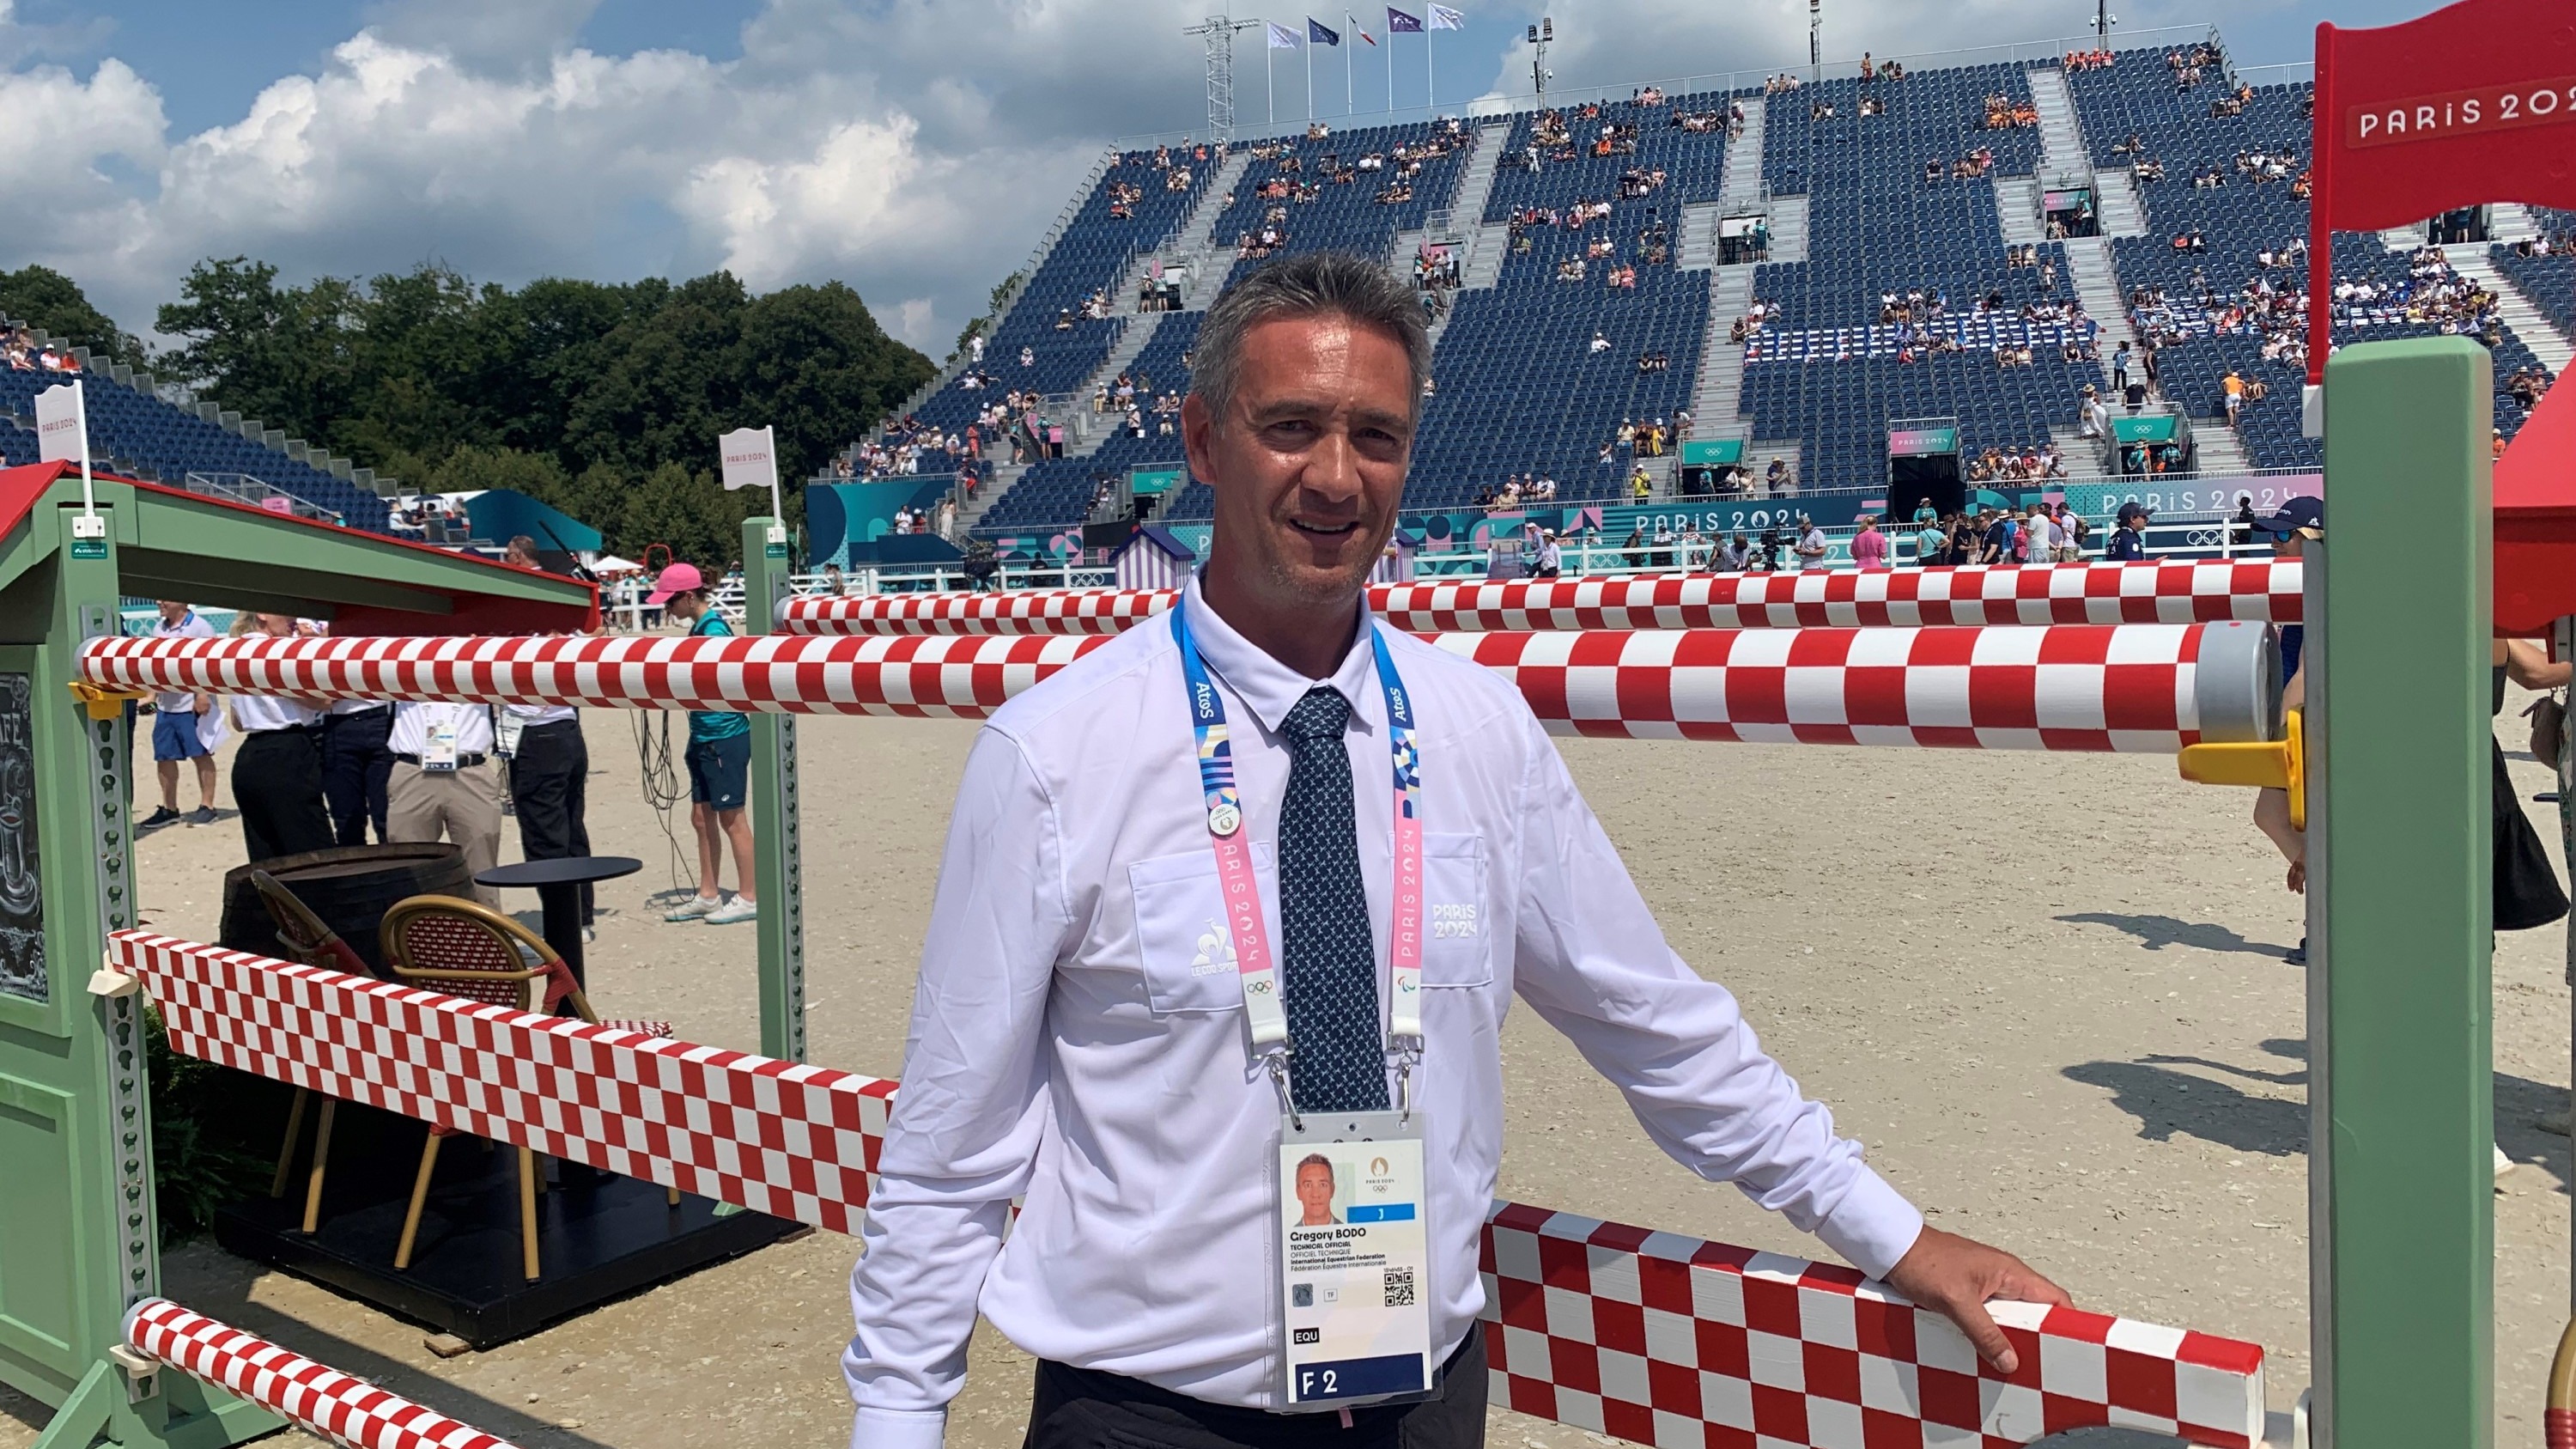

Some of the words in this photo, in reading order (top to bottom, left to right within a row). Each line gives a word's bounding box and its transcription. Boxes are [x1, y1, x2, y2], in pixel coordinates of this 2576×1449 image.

[1196, 681, 1214, 719] Atos
[1389, 686, 1406, 722] Atos
[1402, 830, 1415, 886] 2024
[1235, 903, 1260, 961] 2024
[1434, 920, 1478, 939] 2024
[1191, 966, 1201, 977] LE
[1202, 964, 1217, 976] COQ
[1378, 1208, 1384, 1221] J
[1290, 1230, 1333, 1242] Gregory
[1335, 1227, 1367, 1239] BODO
[1290, 1242, 1324, 1251] TECHNICAL
[1318, 1248, 1352, 1257] TECHNIQUE
[1291, 1263, 1322, 1272] Fédération
[1322, 1262, 1347, 1270] Équestre
[1348, 1259, 1387, 1268] Internationale
[1327, 1255, 1356, 1263] Equestrian
[1295, 1330, 1318, 1342] EQU
[1302, 1372, 1315, 1396] F
[1322, 1369, 1338, 1394] 2
